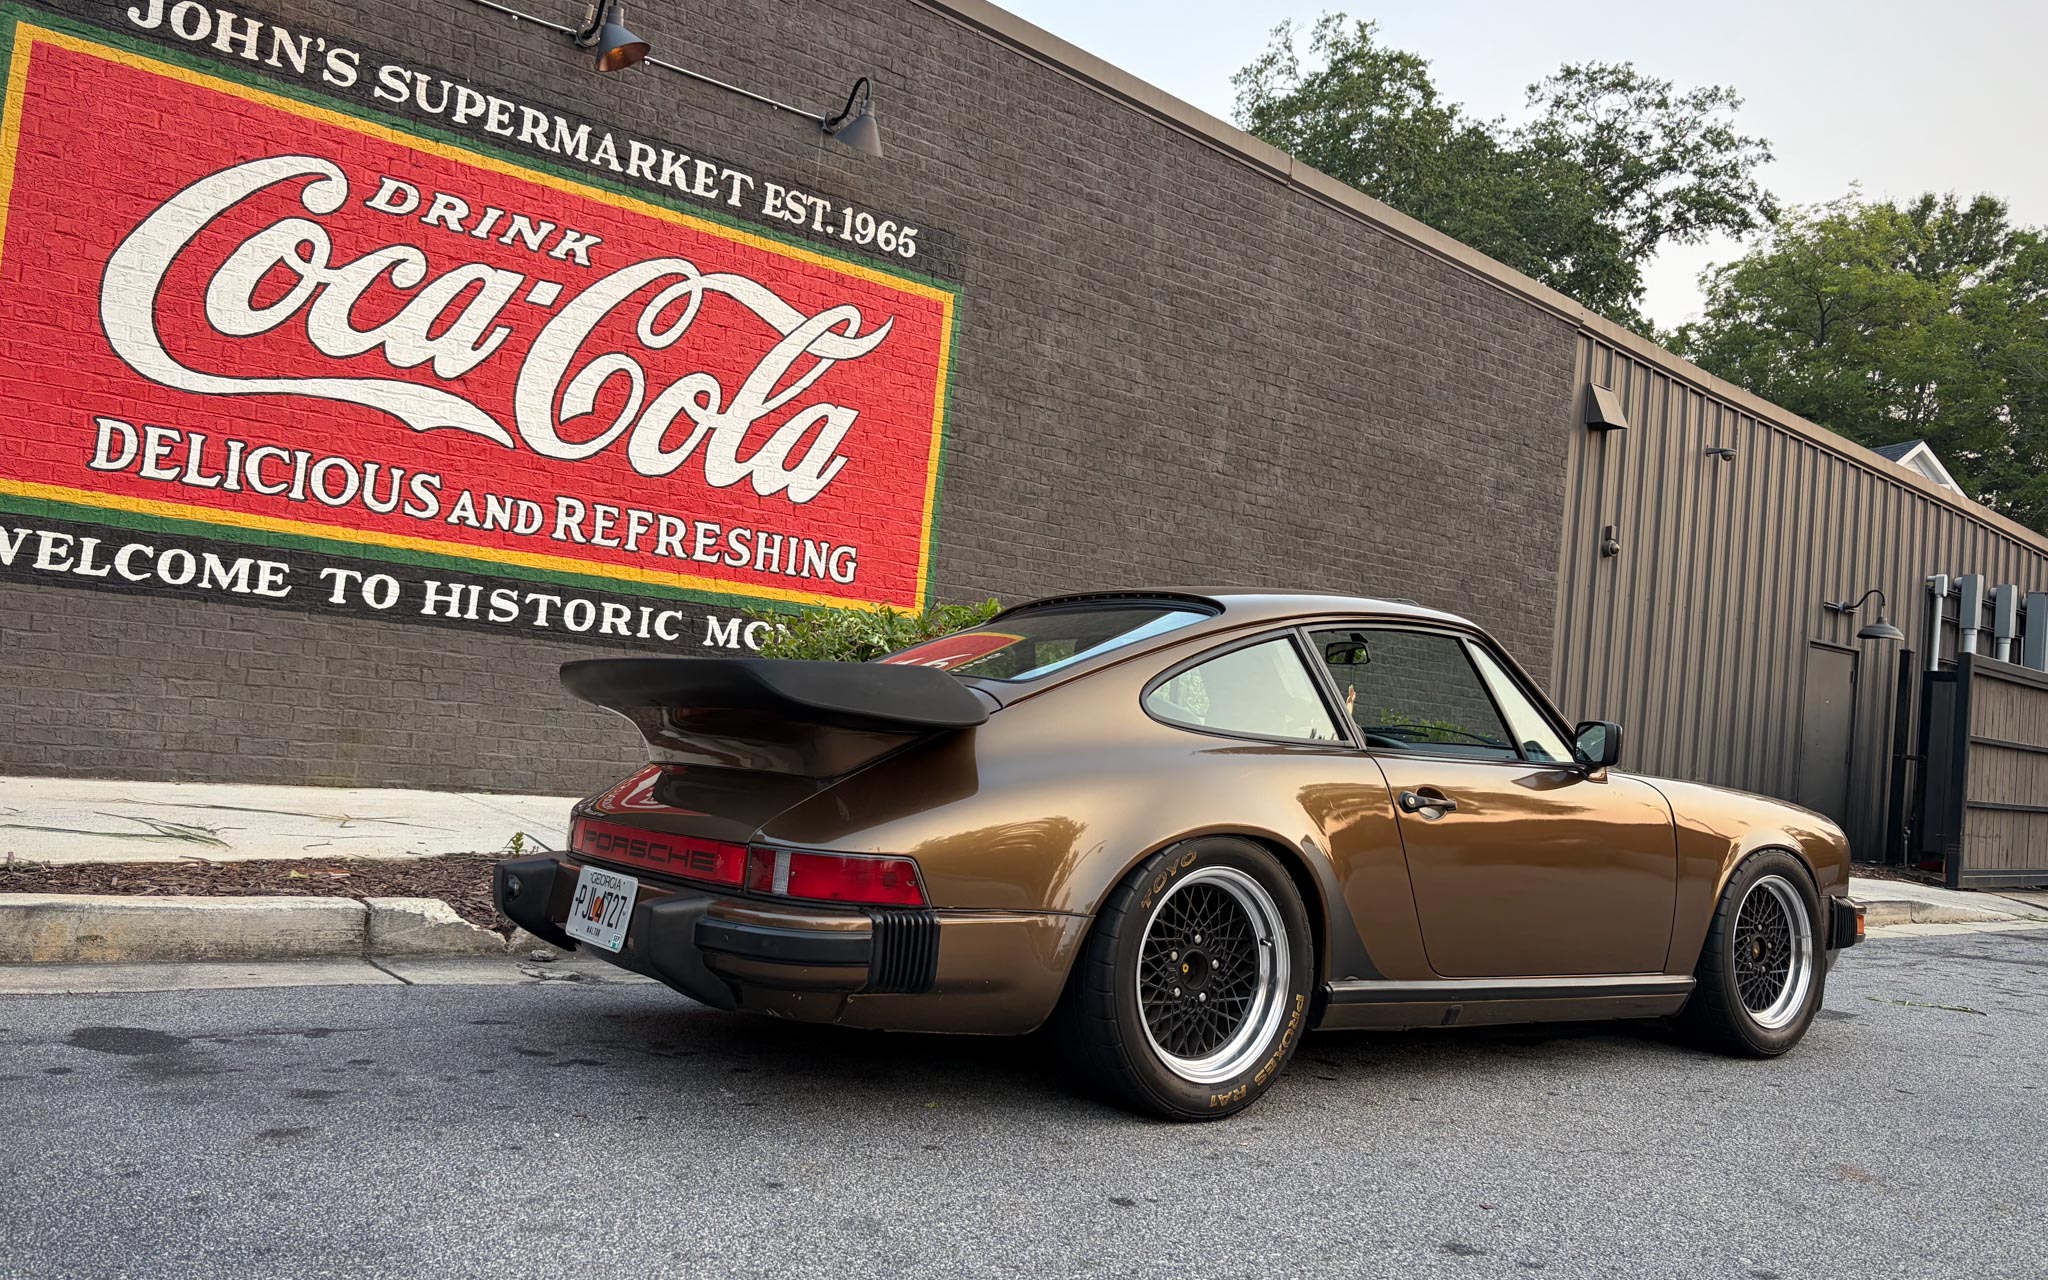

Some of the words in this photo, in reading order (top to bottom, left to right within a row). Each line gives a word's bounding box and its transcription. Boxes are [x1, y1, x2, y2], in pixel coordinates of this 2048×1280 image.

[127, 0, 360, 87] JOHN'S
[374, 65, 755, 206] SUPERMARKET
[365, 176, 603, 267] DRINK
[88, 416, 442, 519] DELICIOUS
[446, 490, 543, 535] AND
[551, 495, 858, 584] REFRESHING
[320, 567, 400, 610] TO
[420, 580, 683, 641] HISTORIC
[584, 829, 716, 872] PORSCHE
[591, 872, 621, 890] GEORGIA
[1141, 850, 1198, 909] TOYO
[1254, 994, 1304, 1086] PROXES
